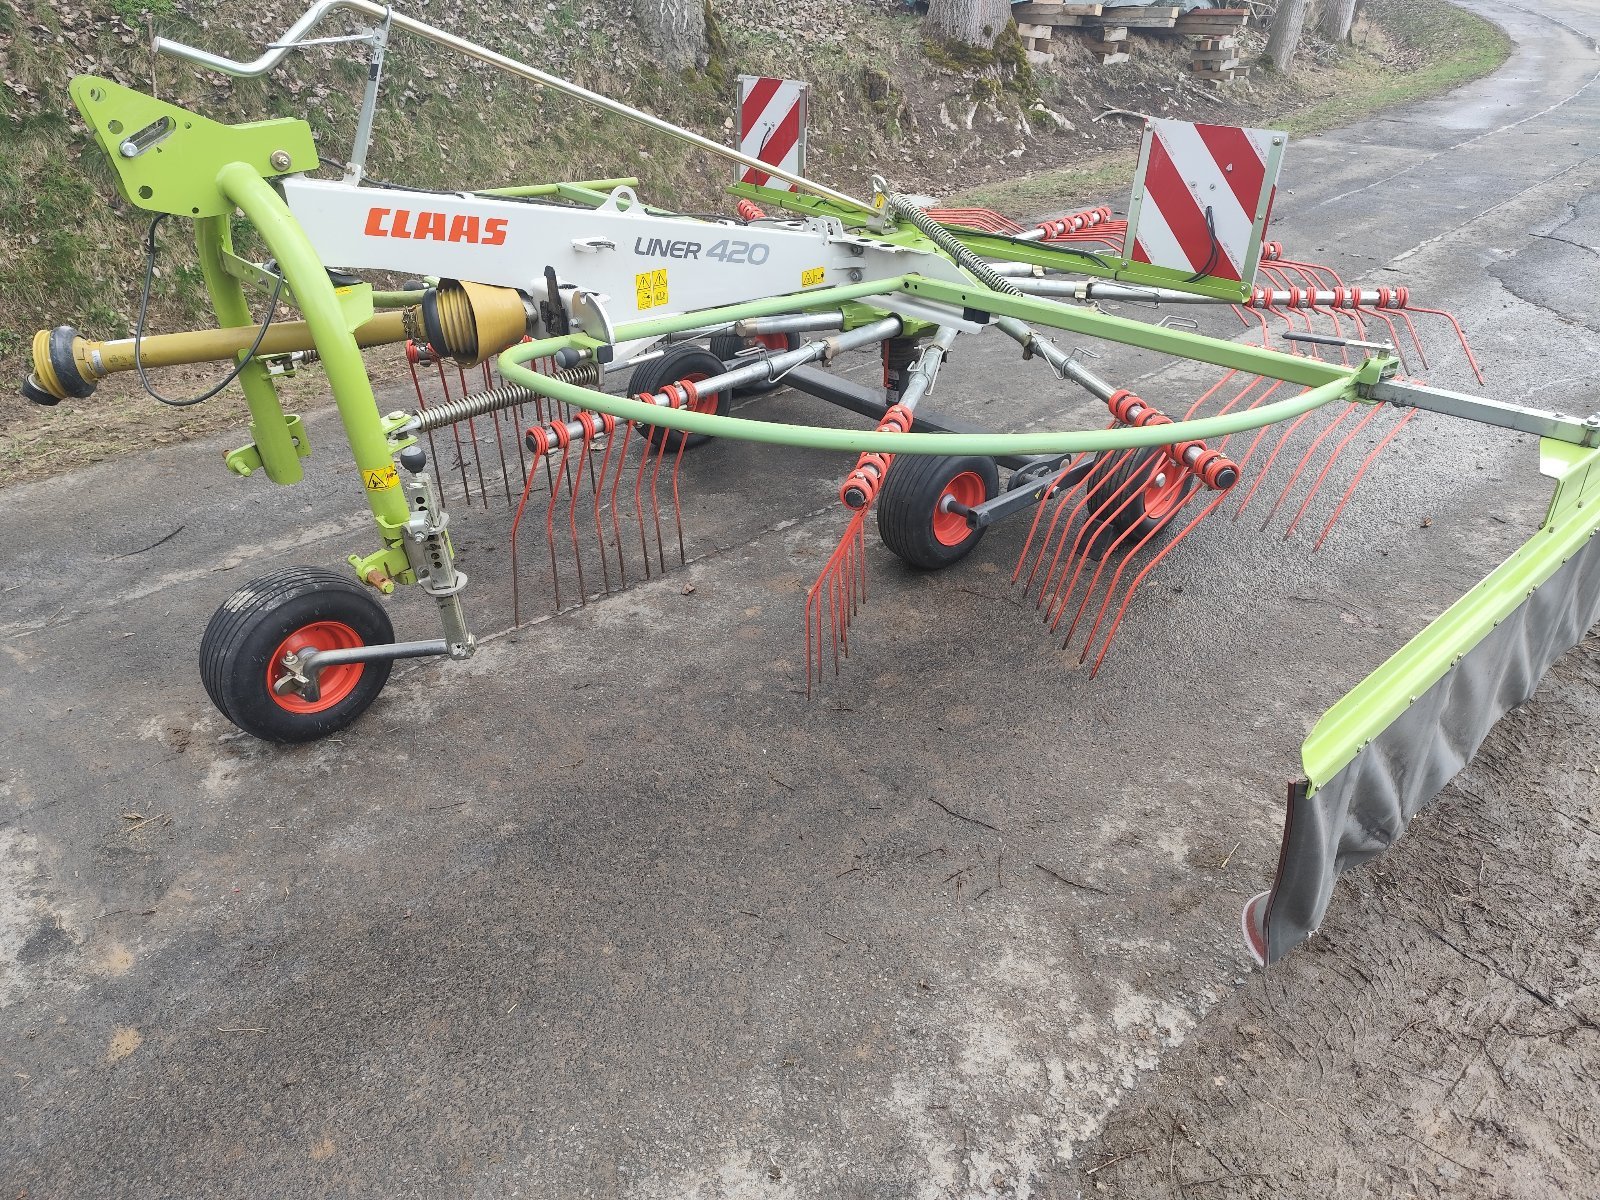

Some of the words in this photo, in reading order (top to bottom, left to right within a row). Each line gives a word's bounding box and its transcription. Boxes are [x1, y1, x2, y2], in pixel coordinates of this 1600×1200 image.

[364, 207, 509, 246] CLAAS
[634, 236, 702, 260] LINER
[705, 239, 770, 266] 420
